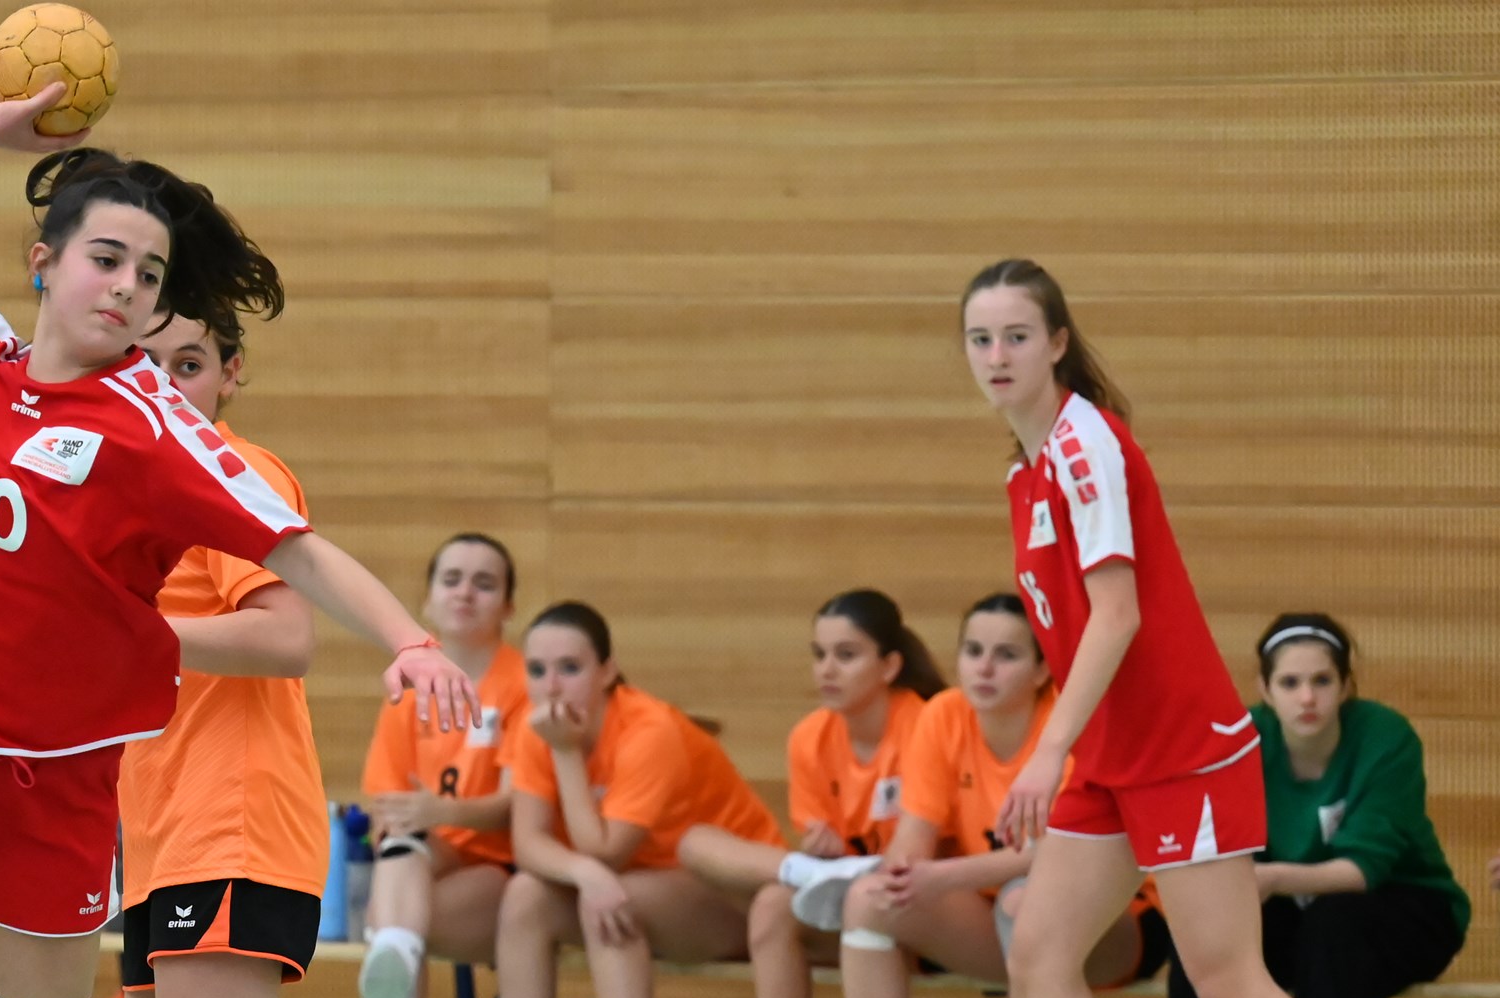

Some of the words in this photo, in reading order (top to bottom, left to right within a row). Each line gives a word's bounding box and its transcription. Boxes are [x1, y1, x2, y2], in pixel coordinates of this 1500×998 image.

[11, 402, 41, 419] erima
[62, 439, 83, 448] HAND
[63, 446, 78, 456] BALL
[79, 904, 103, 915] erima
[168, 919, 196, 928] erima
